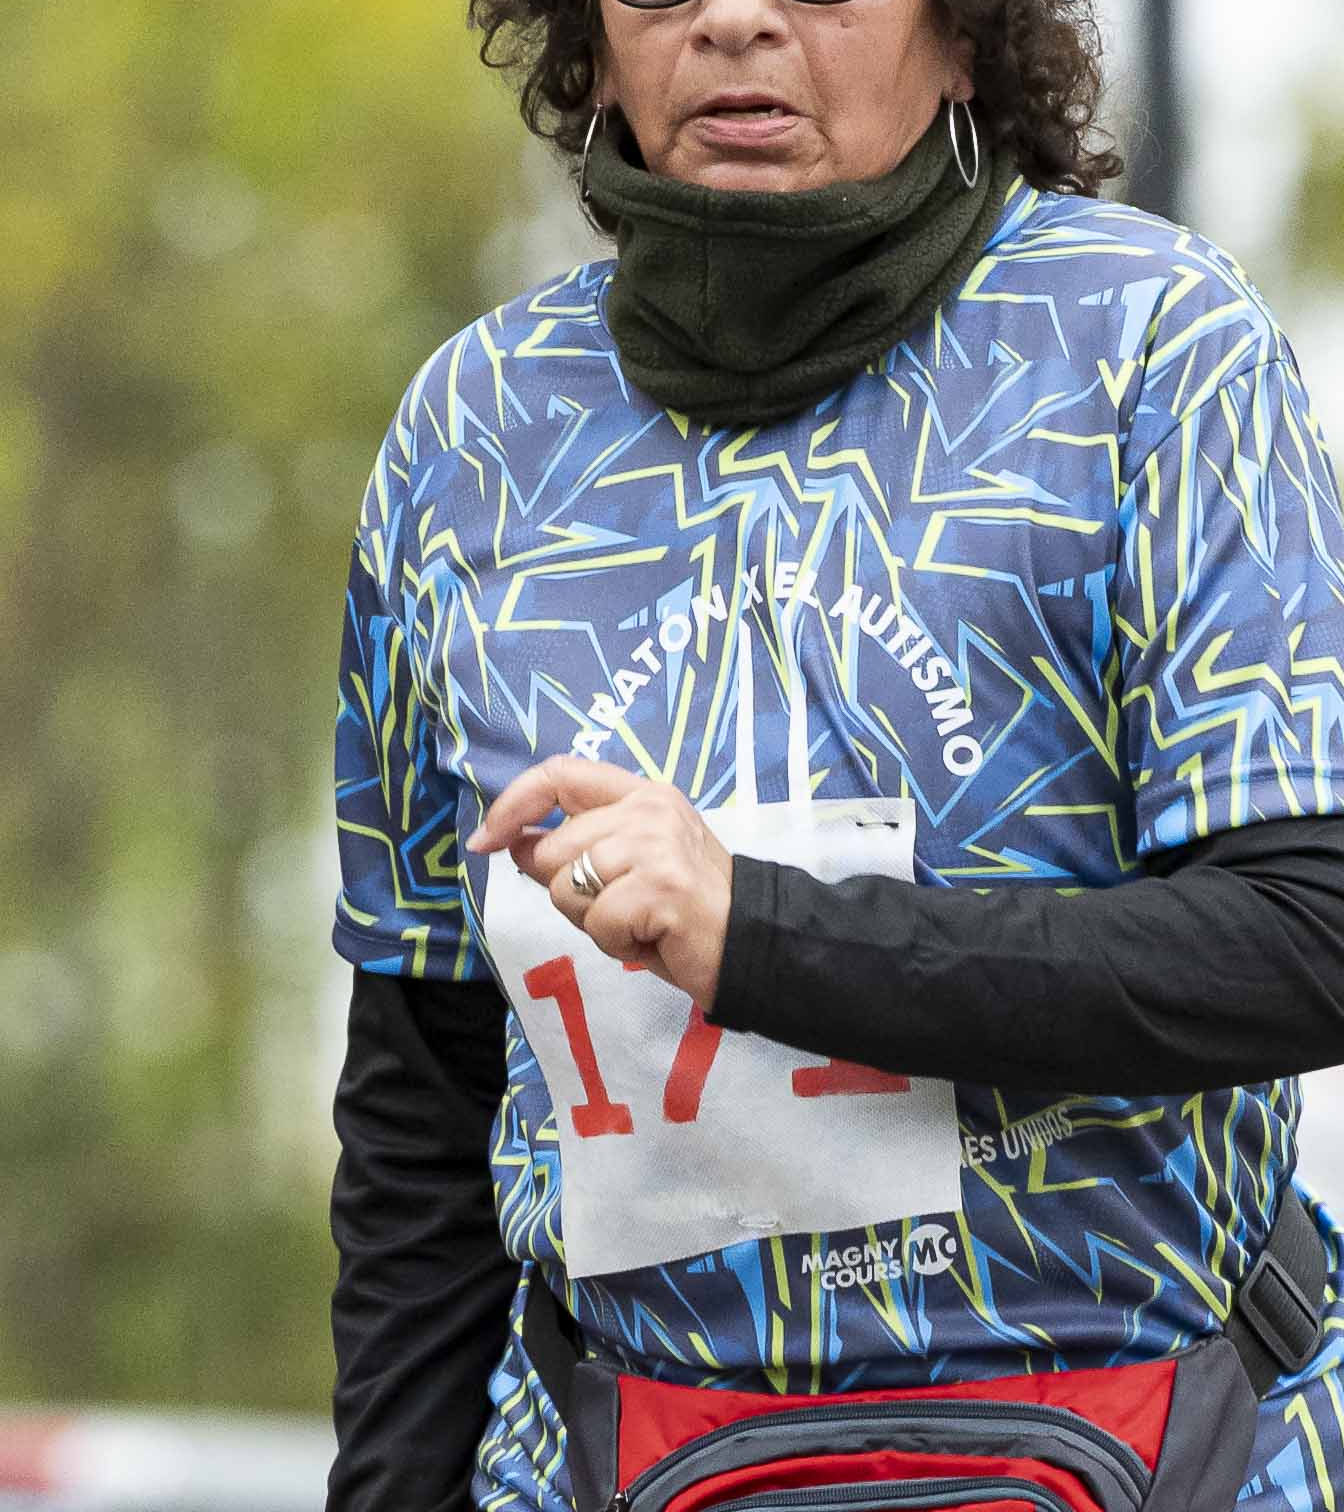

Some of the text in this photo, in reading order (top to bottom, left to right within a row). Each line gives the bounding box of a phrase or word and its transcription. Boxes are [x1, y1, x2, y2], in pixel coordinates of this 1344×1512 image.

[740, 564, 764, 610] X
[774, 561, 819, 609] EL
[828, 584, 984, 777] AUTISMO
[1001, 1106, 1073, 1160] UNIDOS
[801, 1238, 899, 1274] MAGNY
[820, 1259, 904, 1290] COURS
